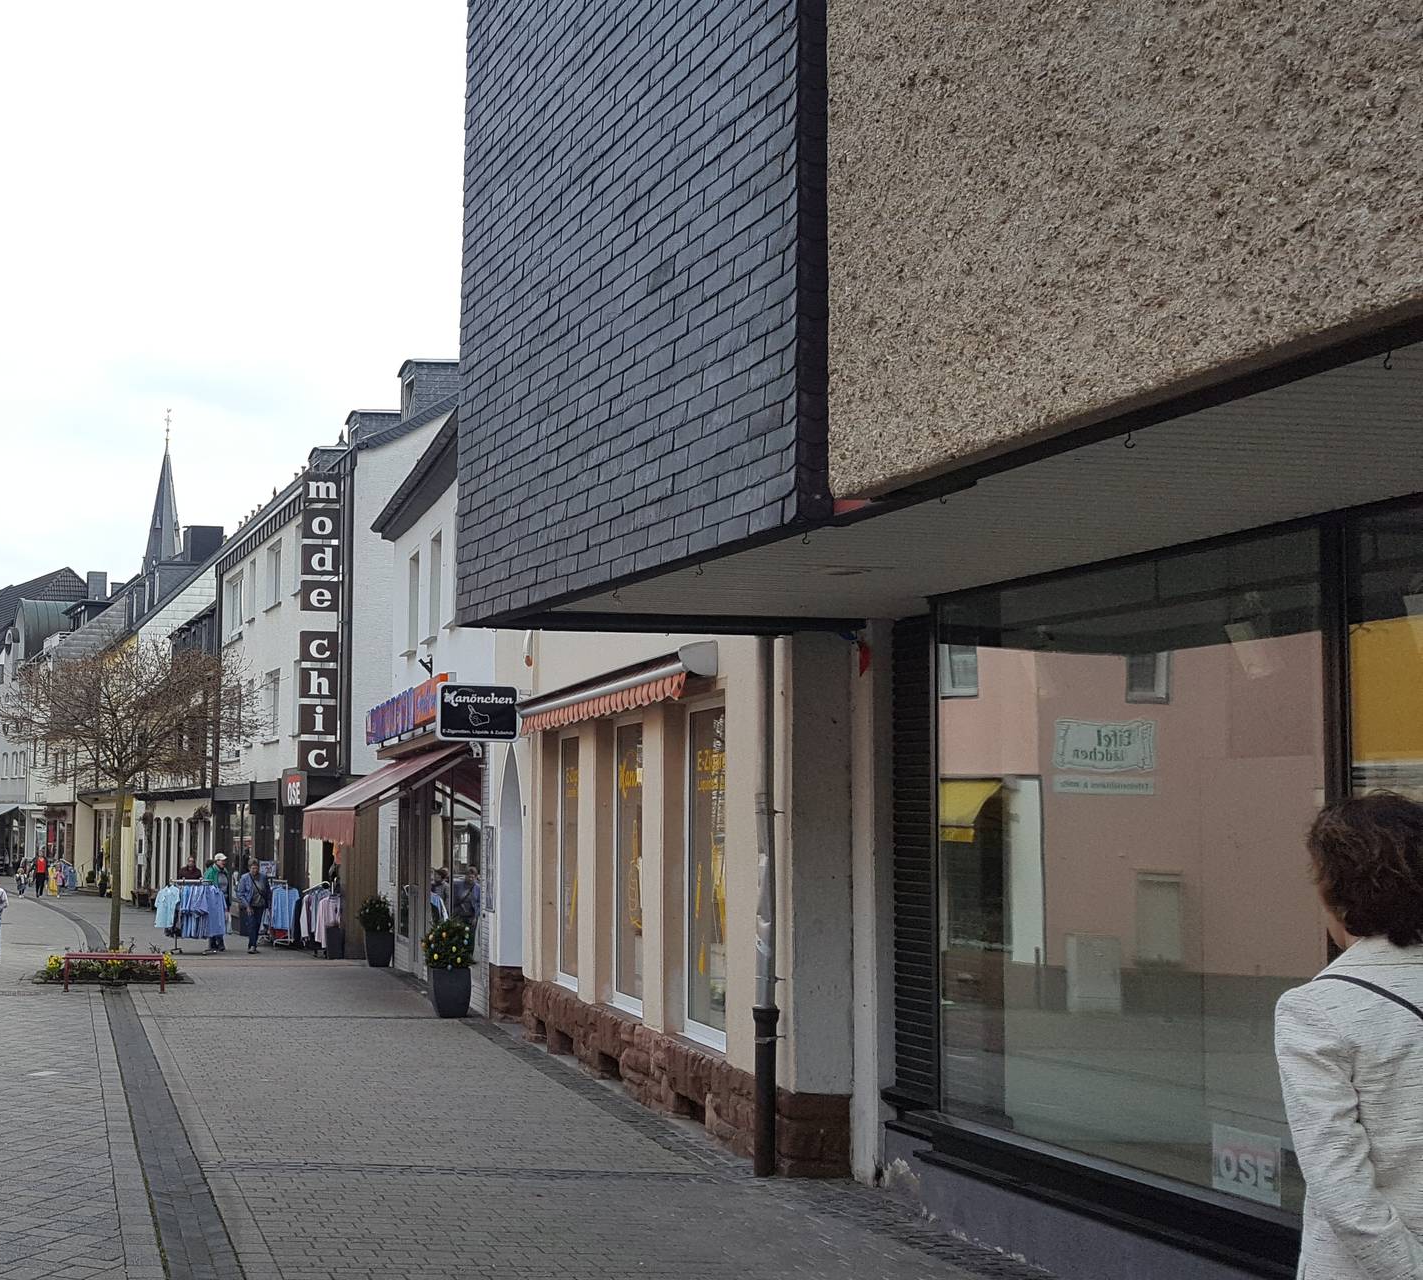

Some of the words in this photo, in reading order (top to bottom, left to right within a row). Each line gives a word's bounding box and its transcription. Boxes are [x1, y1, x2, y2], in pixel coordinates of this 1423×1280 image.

[307, 479, 338, 608] mode
[307, 638, 331, 769] chic
[443, 688, 515, 707] Kanönchen
[1218, 1149, 1276, 1189] OSE
